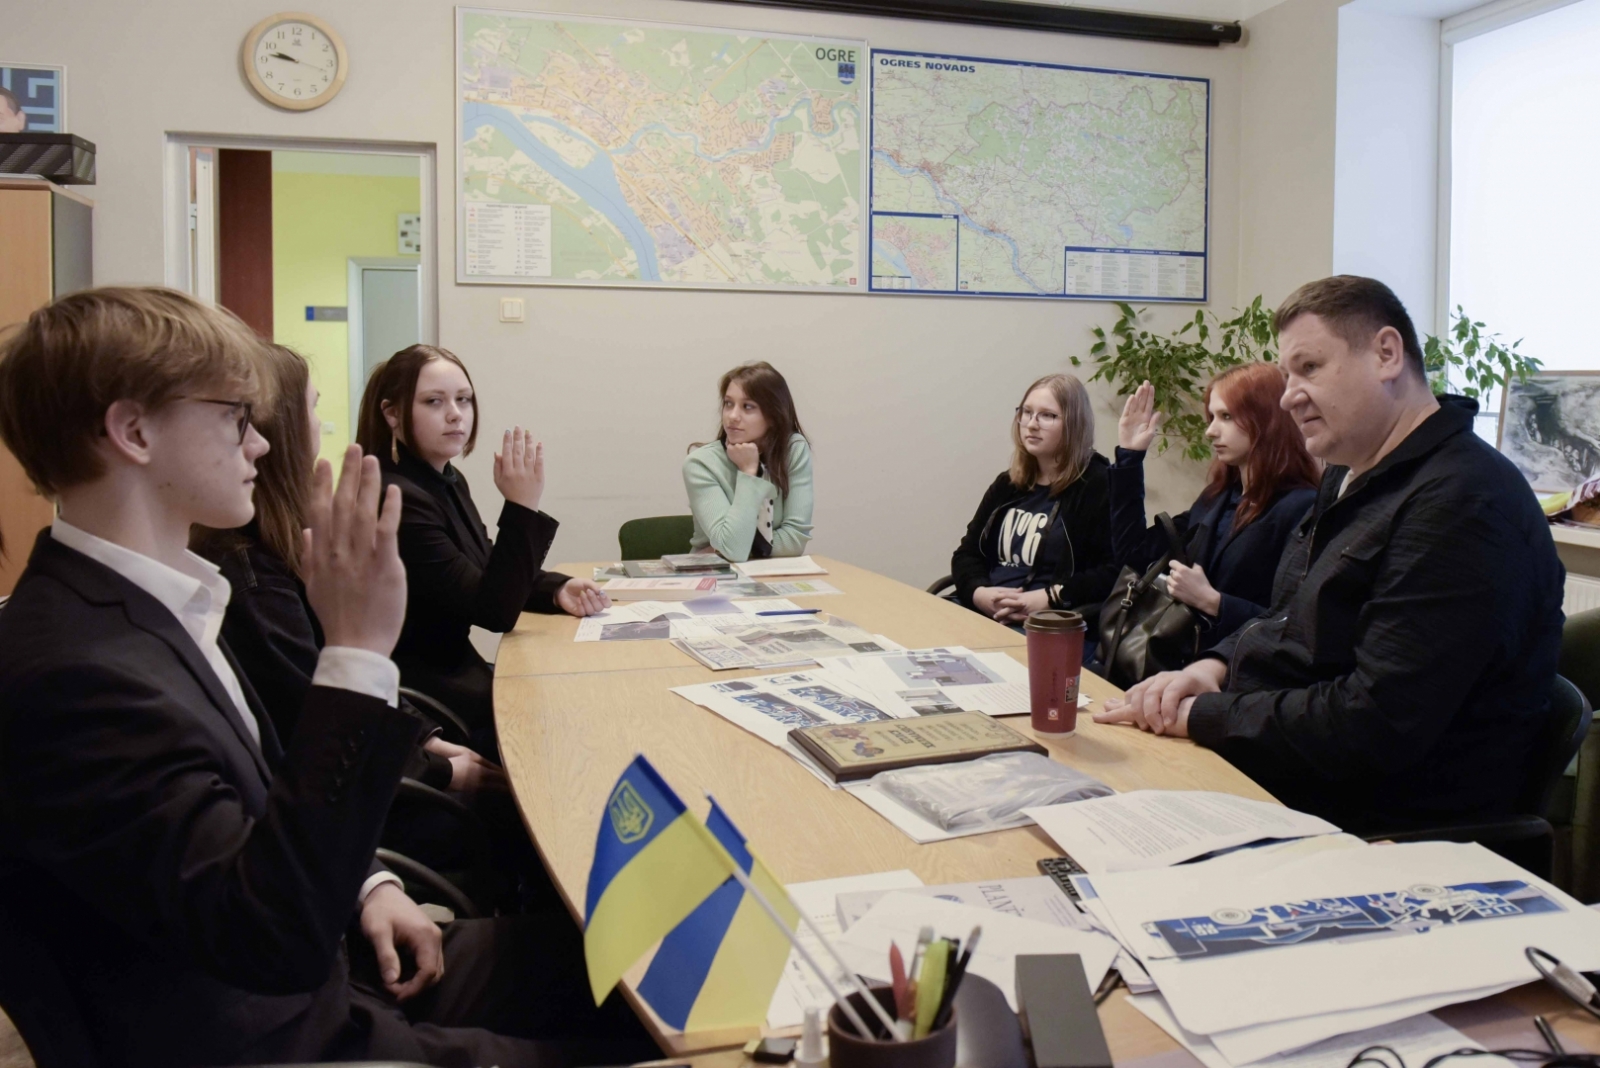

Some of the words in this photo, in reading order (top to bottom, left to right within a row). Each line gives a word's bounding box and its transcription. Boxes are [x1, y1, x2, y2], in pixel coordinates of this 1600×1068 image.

[277, 31, 285, 39] 11
[292, 27, 302, 36] 12
[265, 42, 277, 50] 10
[322, 43, 329, 52] 2
[260, 55, 268, 64] 9
[815, 47, 856, 63] OGRE
[326, 60, 334, 68] 3
[880, 58, 921, 69] OGRES
[925, 61, 976, 73] NOVADS
[265, 71, 274, 79] 8
[278, 82, 285, 91] 7
[310, 84, 318, 93] 5
[293, 87, 302, 96] 6
